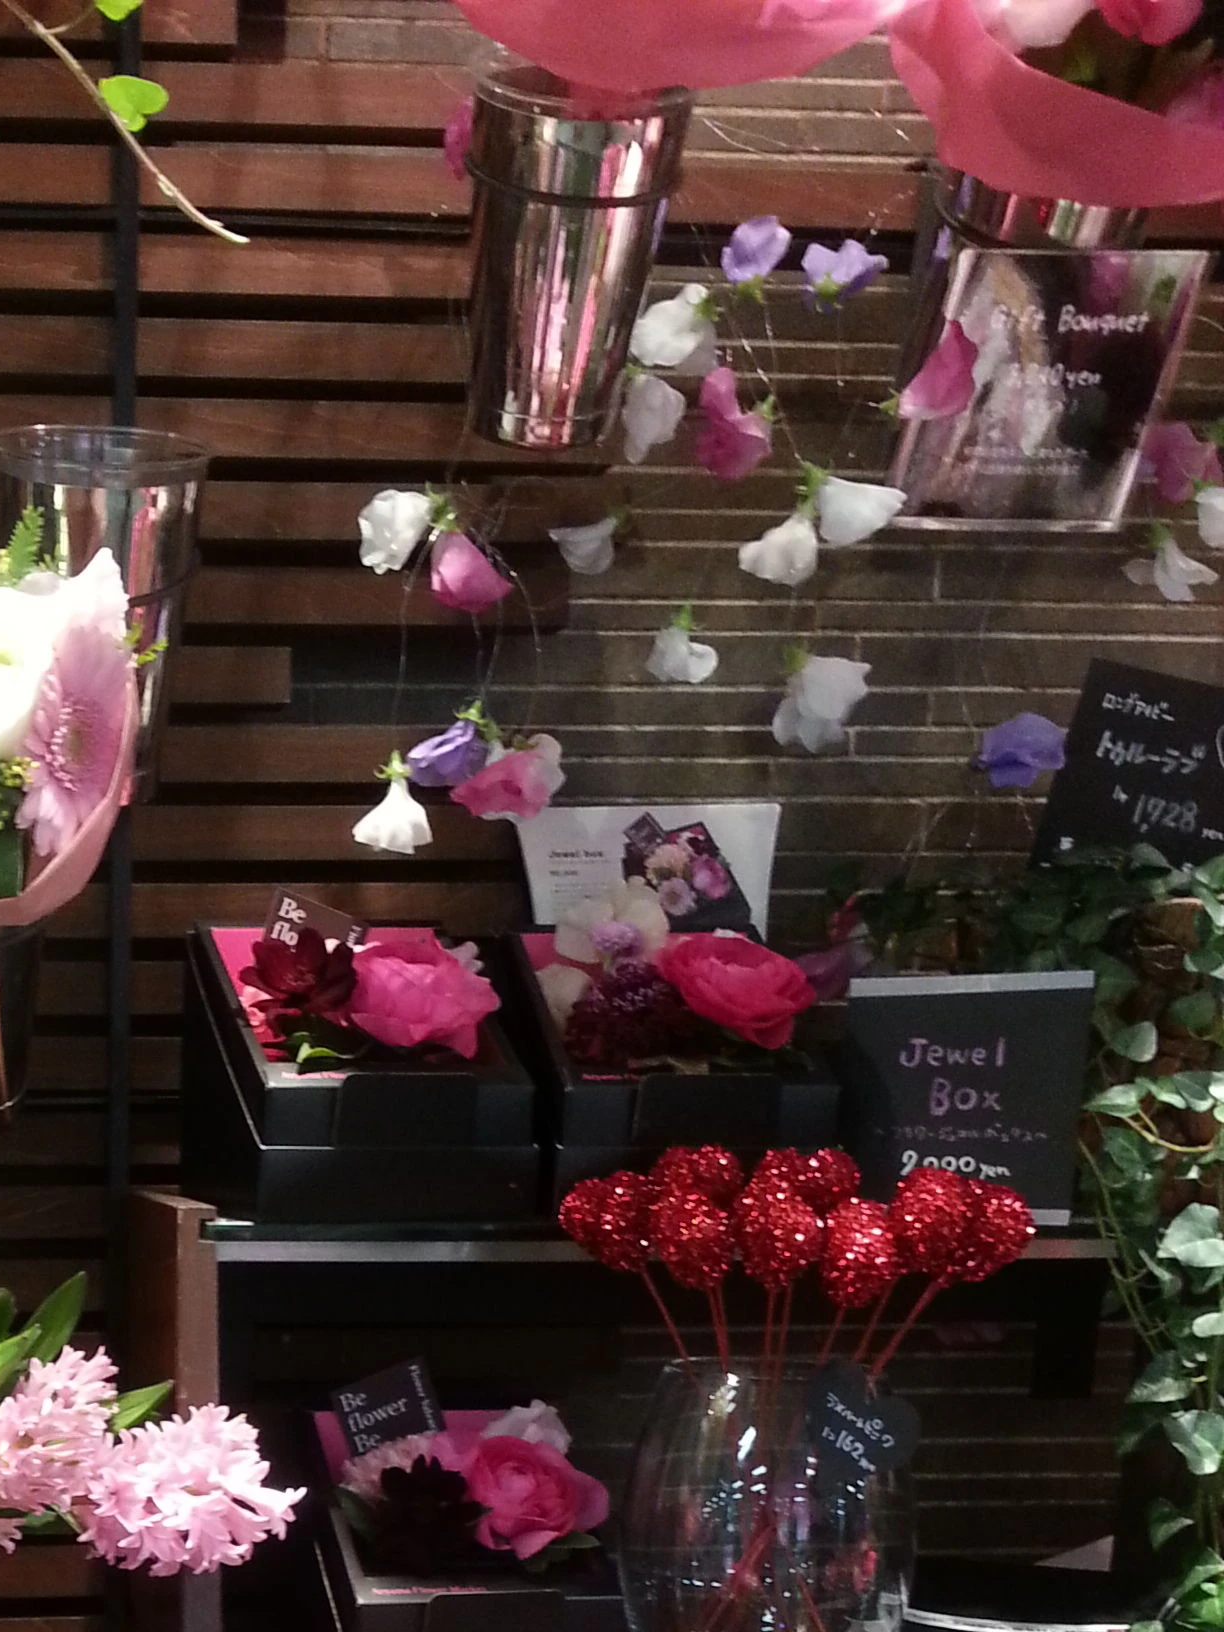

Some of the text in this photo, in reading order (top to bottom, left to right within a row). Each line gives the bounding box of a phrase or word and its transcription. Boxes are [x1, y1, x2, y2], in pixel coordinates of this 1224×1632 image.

[1057, 304, 1150, 336] Bouquet
[278, 896, 307, 924] Be
[899, 1036, 1006, 1068] Jewel
[929, 1077, 1002, 1116] Box
[339, 1391, 368, 1413] Be
[346, 1396, 408, 1434] flower
